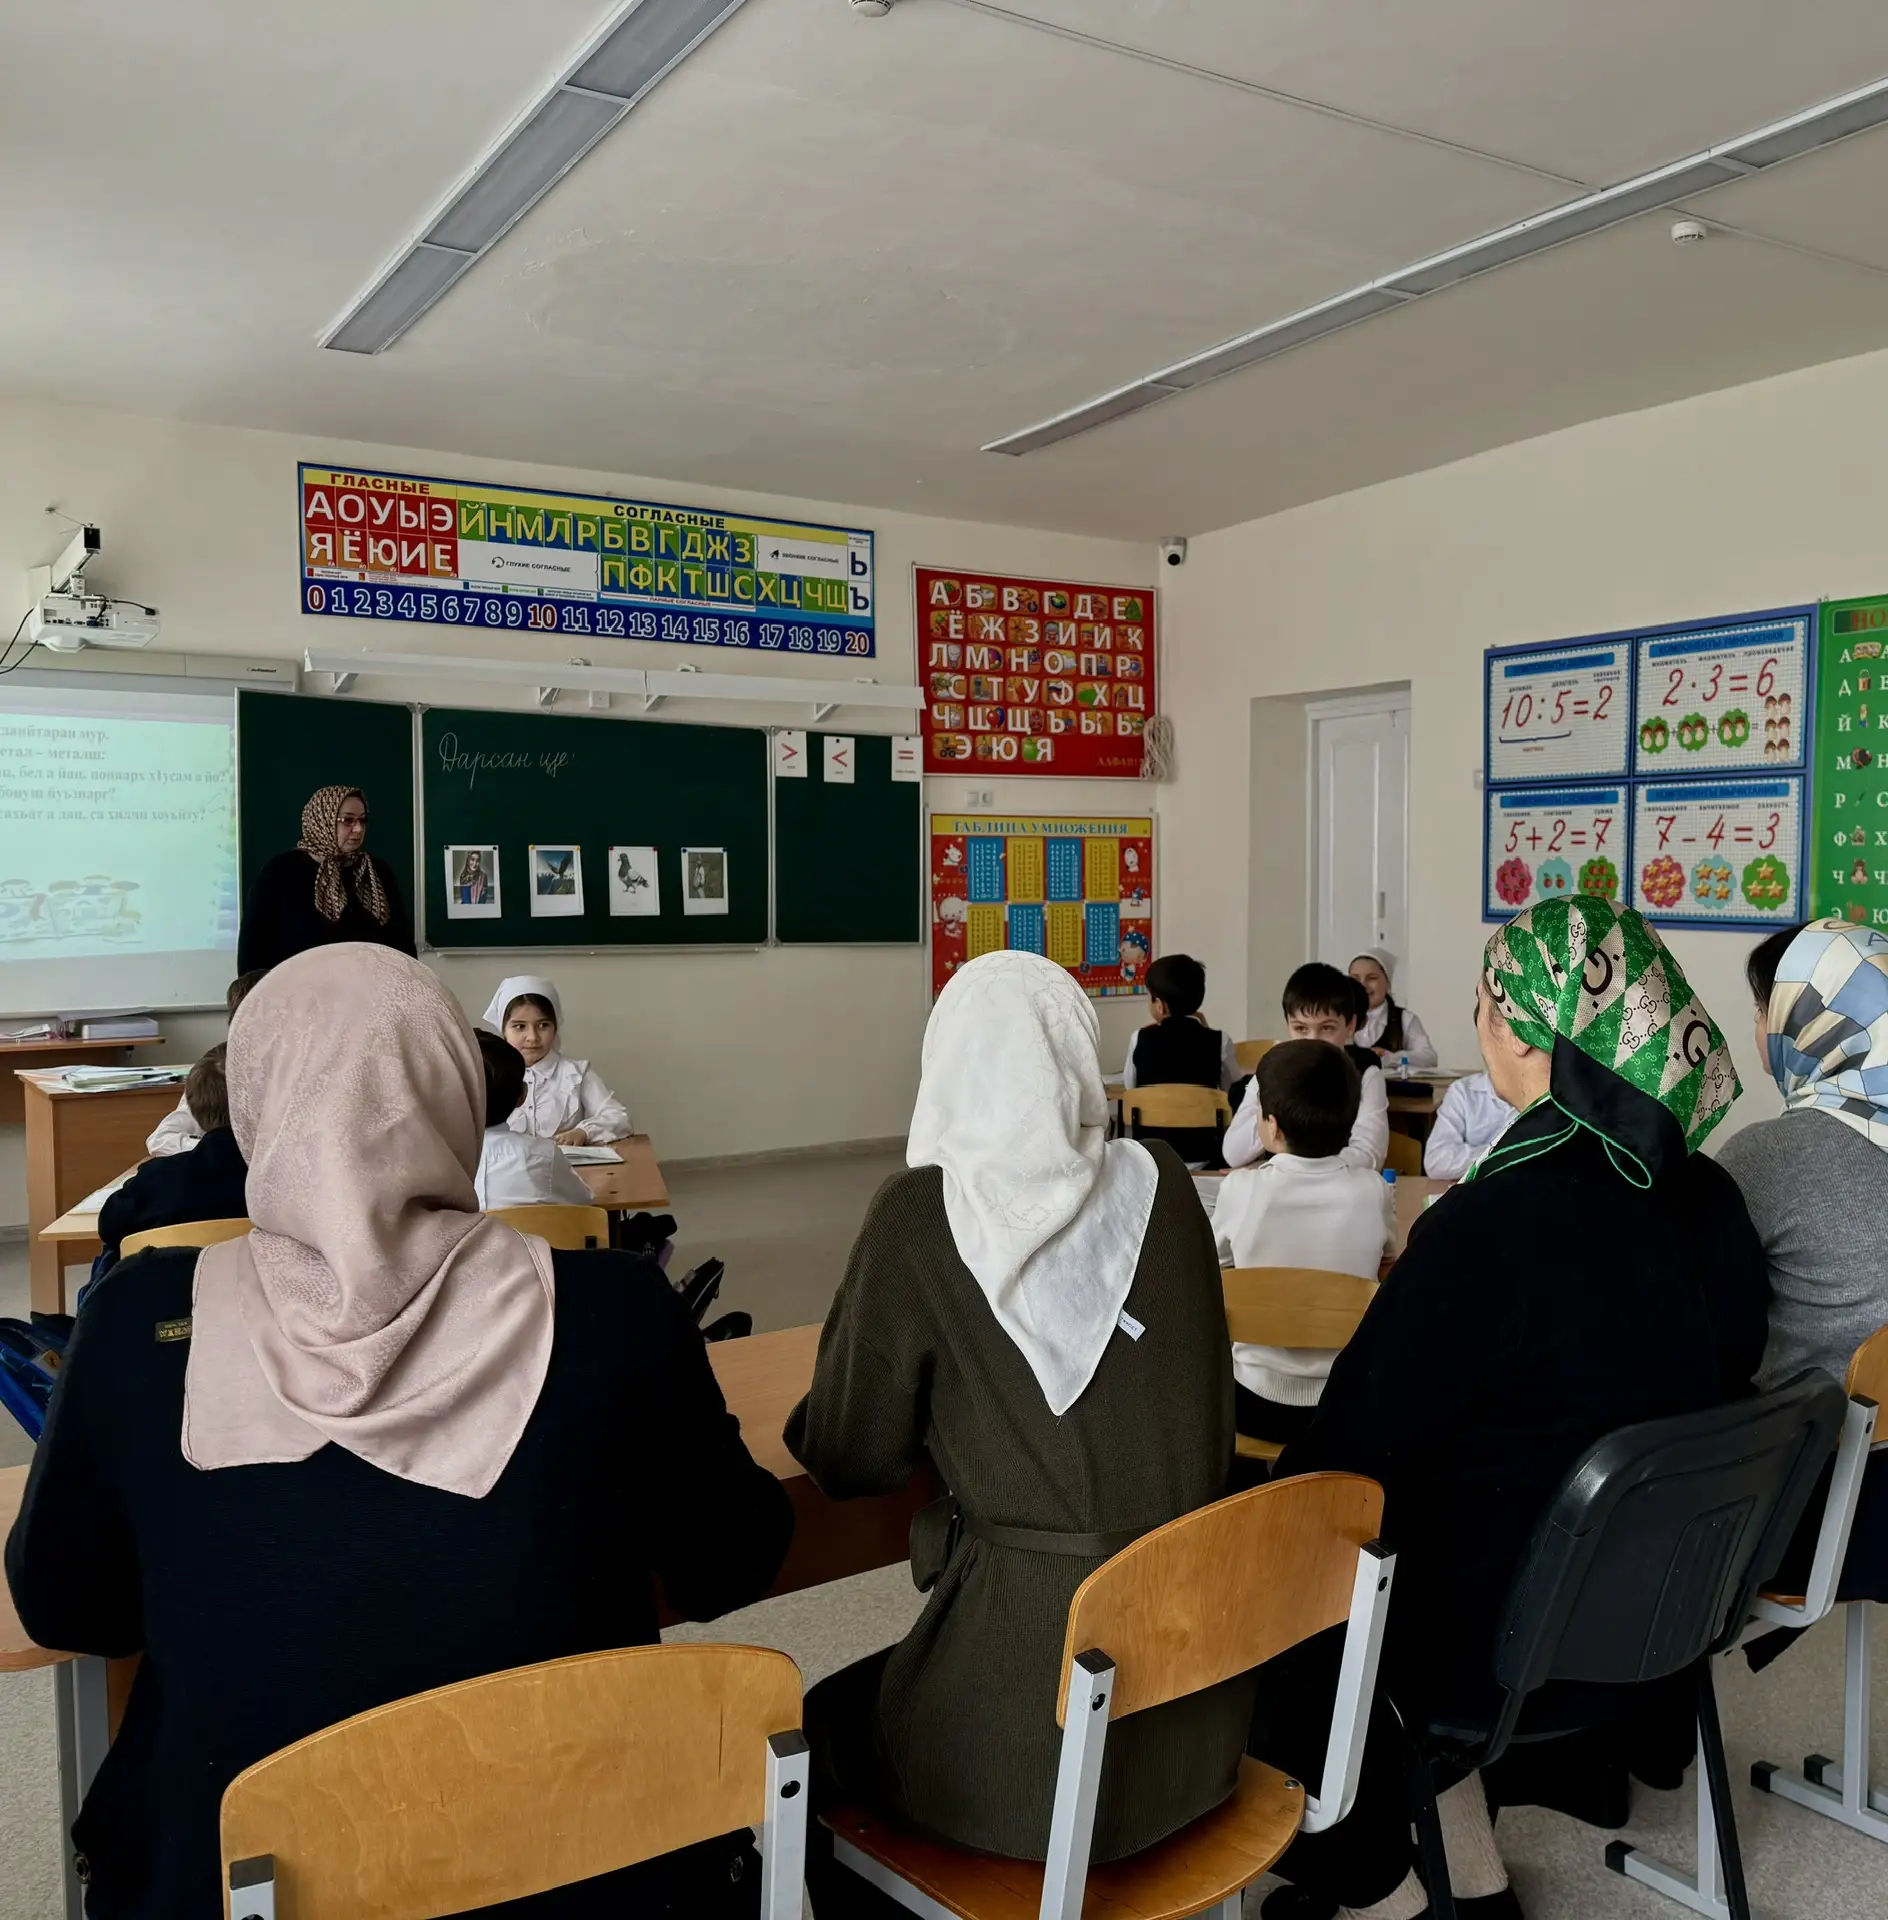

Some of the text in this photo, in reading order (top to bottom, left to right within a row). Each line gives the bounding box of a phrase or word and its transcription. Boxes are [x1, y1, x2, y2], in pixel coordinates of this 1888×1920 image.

[330, 473, 430, 495] ГЛАСНЫЕ
[614, 504, 725, 529] СОГЛАСНЫЕ
[531, 563, 571, 573] СОГЛАСНЫЕ
[307, 585, 869, 654] 0 1 2 3 4 5 6 7 8 9 10 11 12 13 14 15 16 17 18 19 20
[438, 732, 533, 790] Дарсан
[953, 821, 1129, 836] ТАБЛИЦА УМНОЖЕНИЯ
